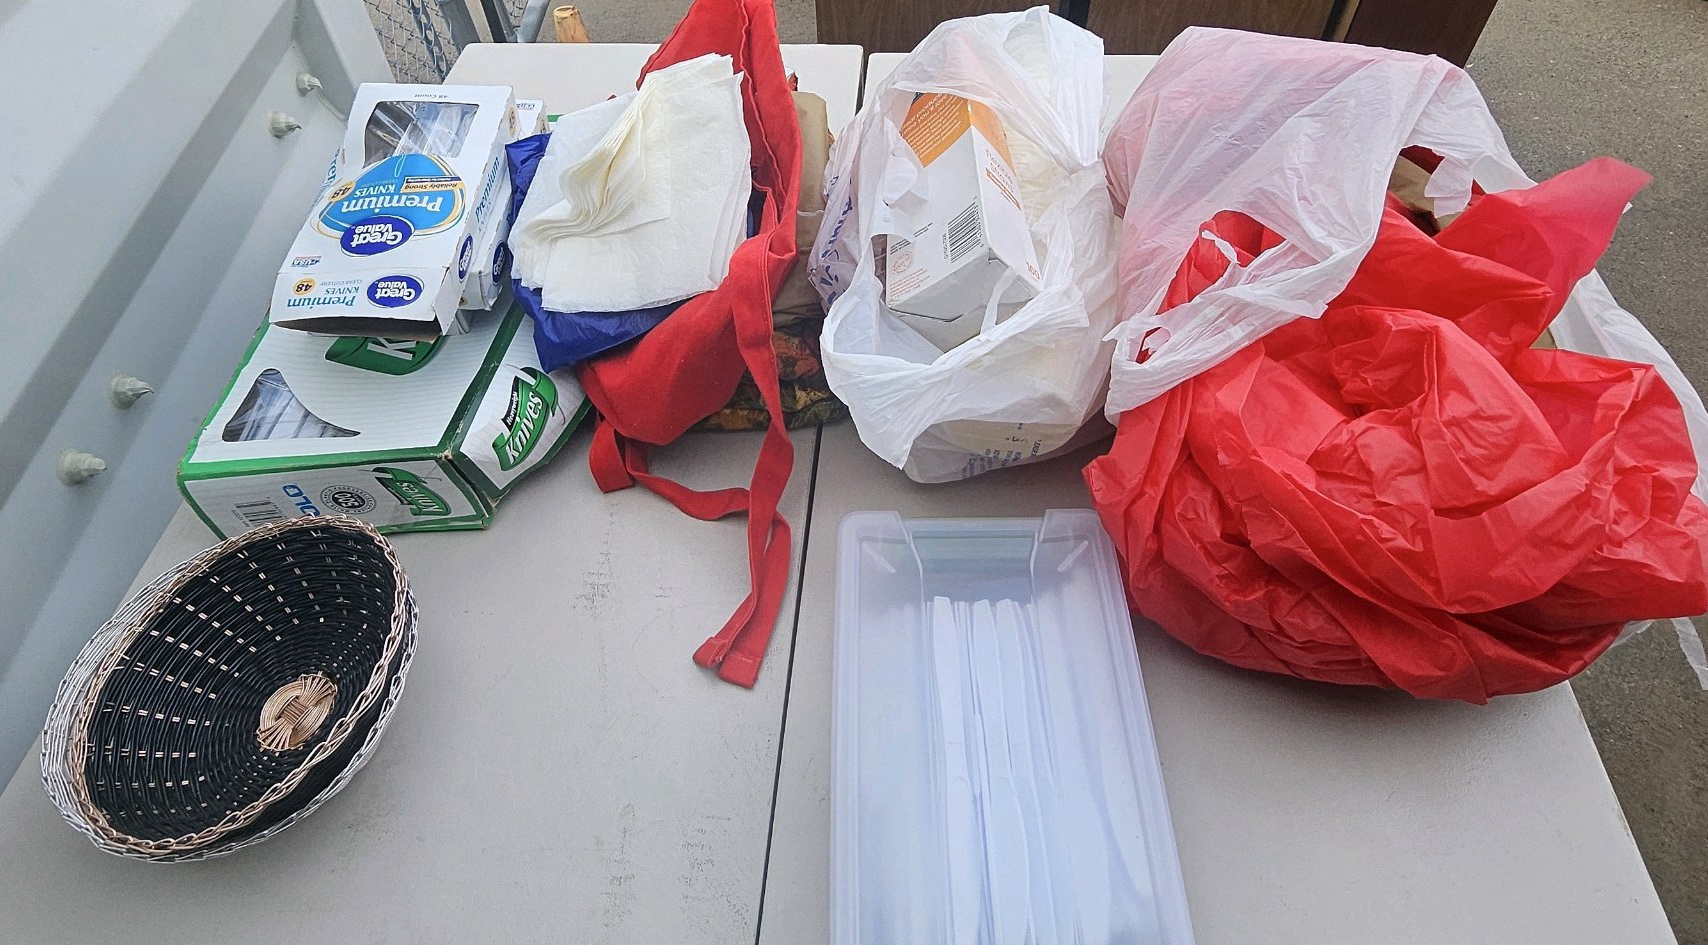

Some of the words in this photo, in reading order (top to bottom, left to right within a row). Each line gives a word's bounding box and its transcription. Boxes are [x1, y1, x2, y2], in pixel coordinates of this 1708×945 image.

[331, 186, 352, 199] 48
[354, 184, 396, 198] KNIVES
[474, 156, 500, 223] Premium
[341, 195, 444, 213] Premium
[355, 223, 394, 234] Value
[351, 230, 403, 247] Great
[295, 283, 313, 293] 48
[324, 286, 360, 295] KNIVES
[378, 281, 407, 290] Value
[374, 288, 416, 301] Great
[287, 295, 356, 309] Premium
[505, 391, 543, 464] Knives
[334, 492, 359, 507] 500
[396, 482, 444, 512] Knives
